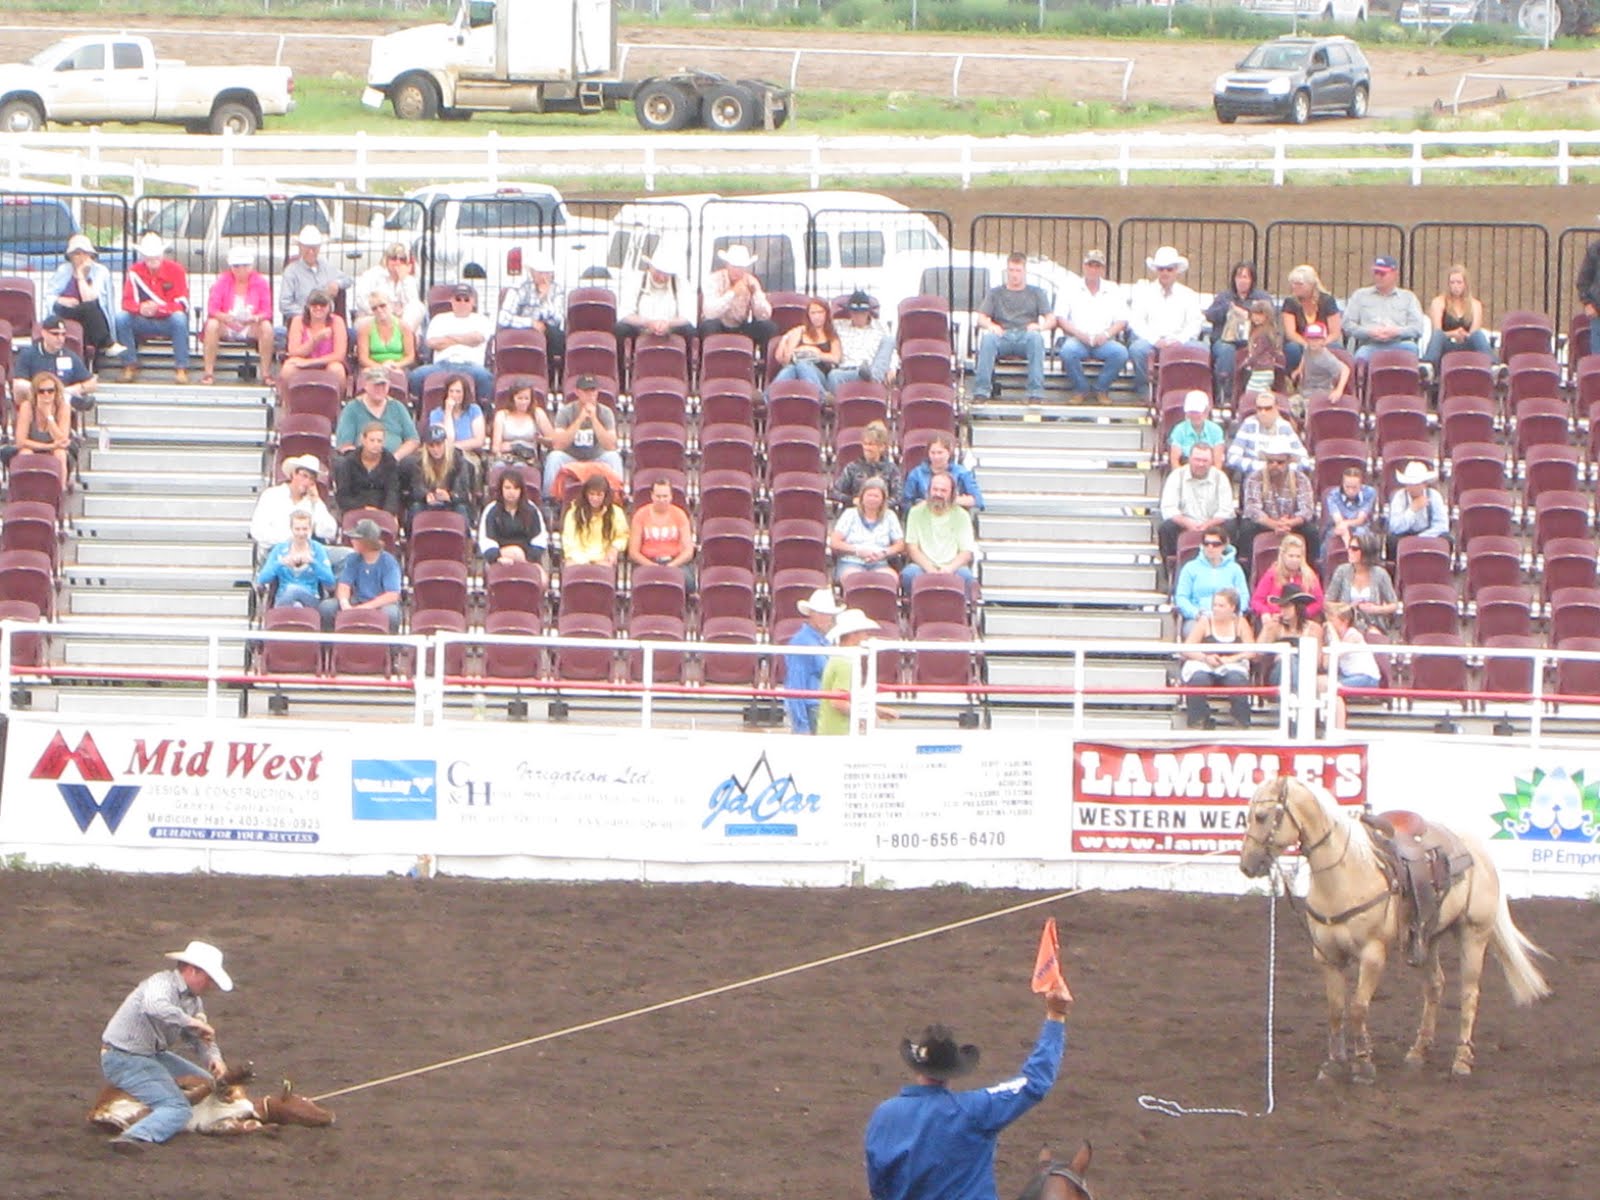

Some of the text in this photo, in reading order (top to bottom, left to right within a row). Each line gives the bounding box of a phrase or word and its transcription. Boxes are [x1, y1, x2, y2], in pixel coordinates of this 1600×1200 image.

[123, 738, 323, 782] Mid West
[206, 785, 295, 801] CONSTRUCTION
[702, 777, 821, 830] JaCar
[147, 812, 199, 825] Medicine
[205, 815, 225, 826] Hat
[1079, 807, 1248, 829] WESTERN WEA
[155, 828, 314, 843] BUILDING FOR YOUR SUCCESS
[875, 831, 1006, 849] 1-800-656-6470
[1079, 835, 1243, 851] www.lamm
[1532, 848, 1600, 868] BP Empr
